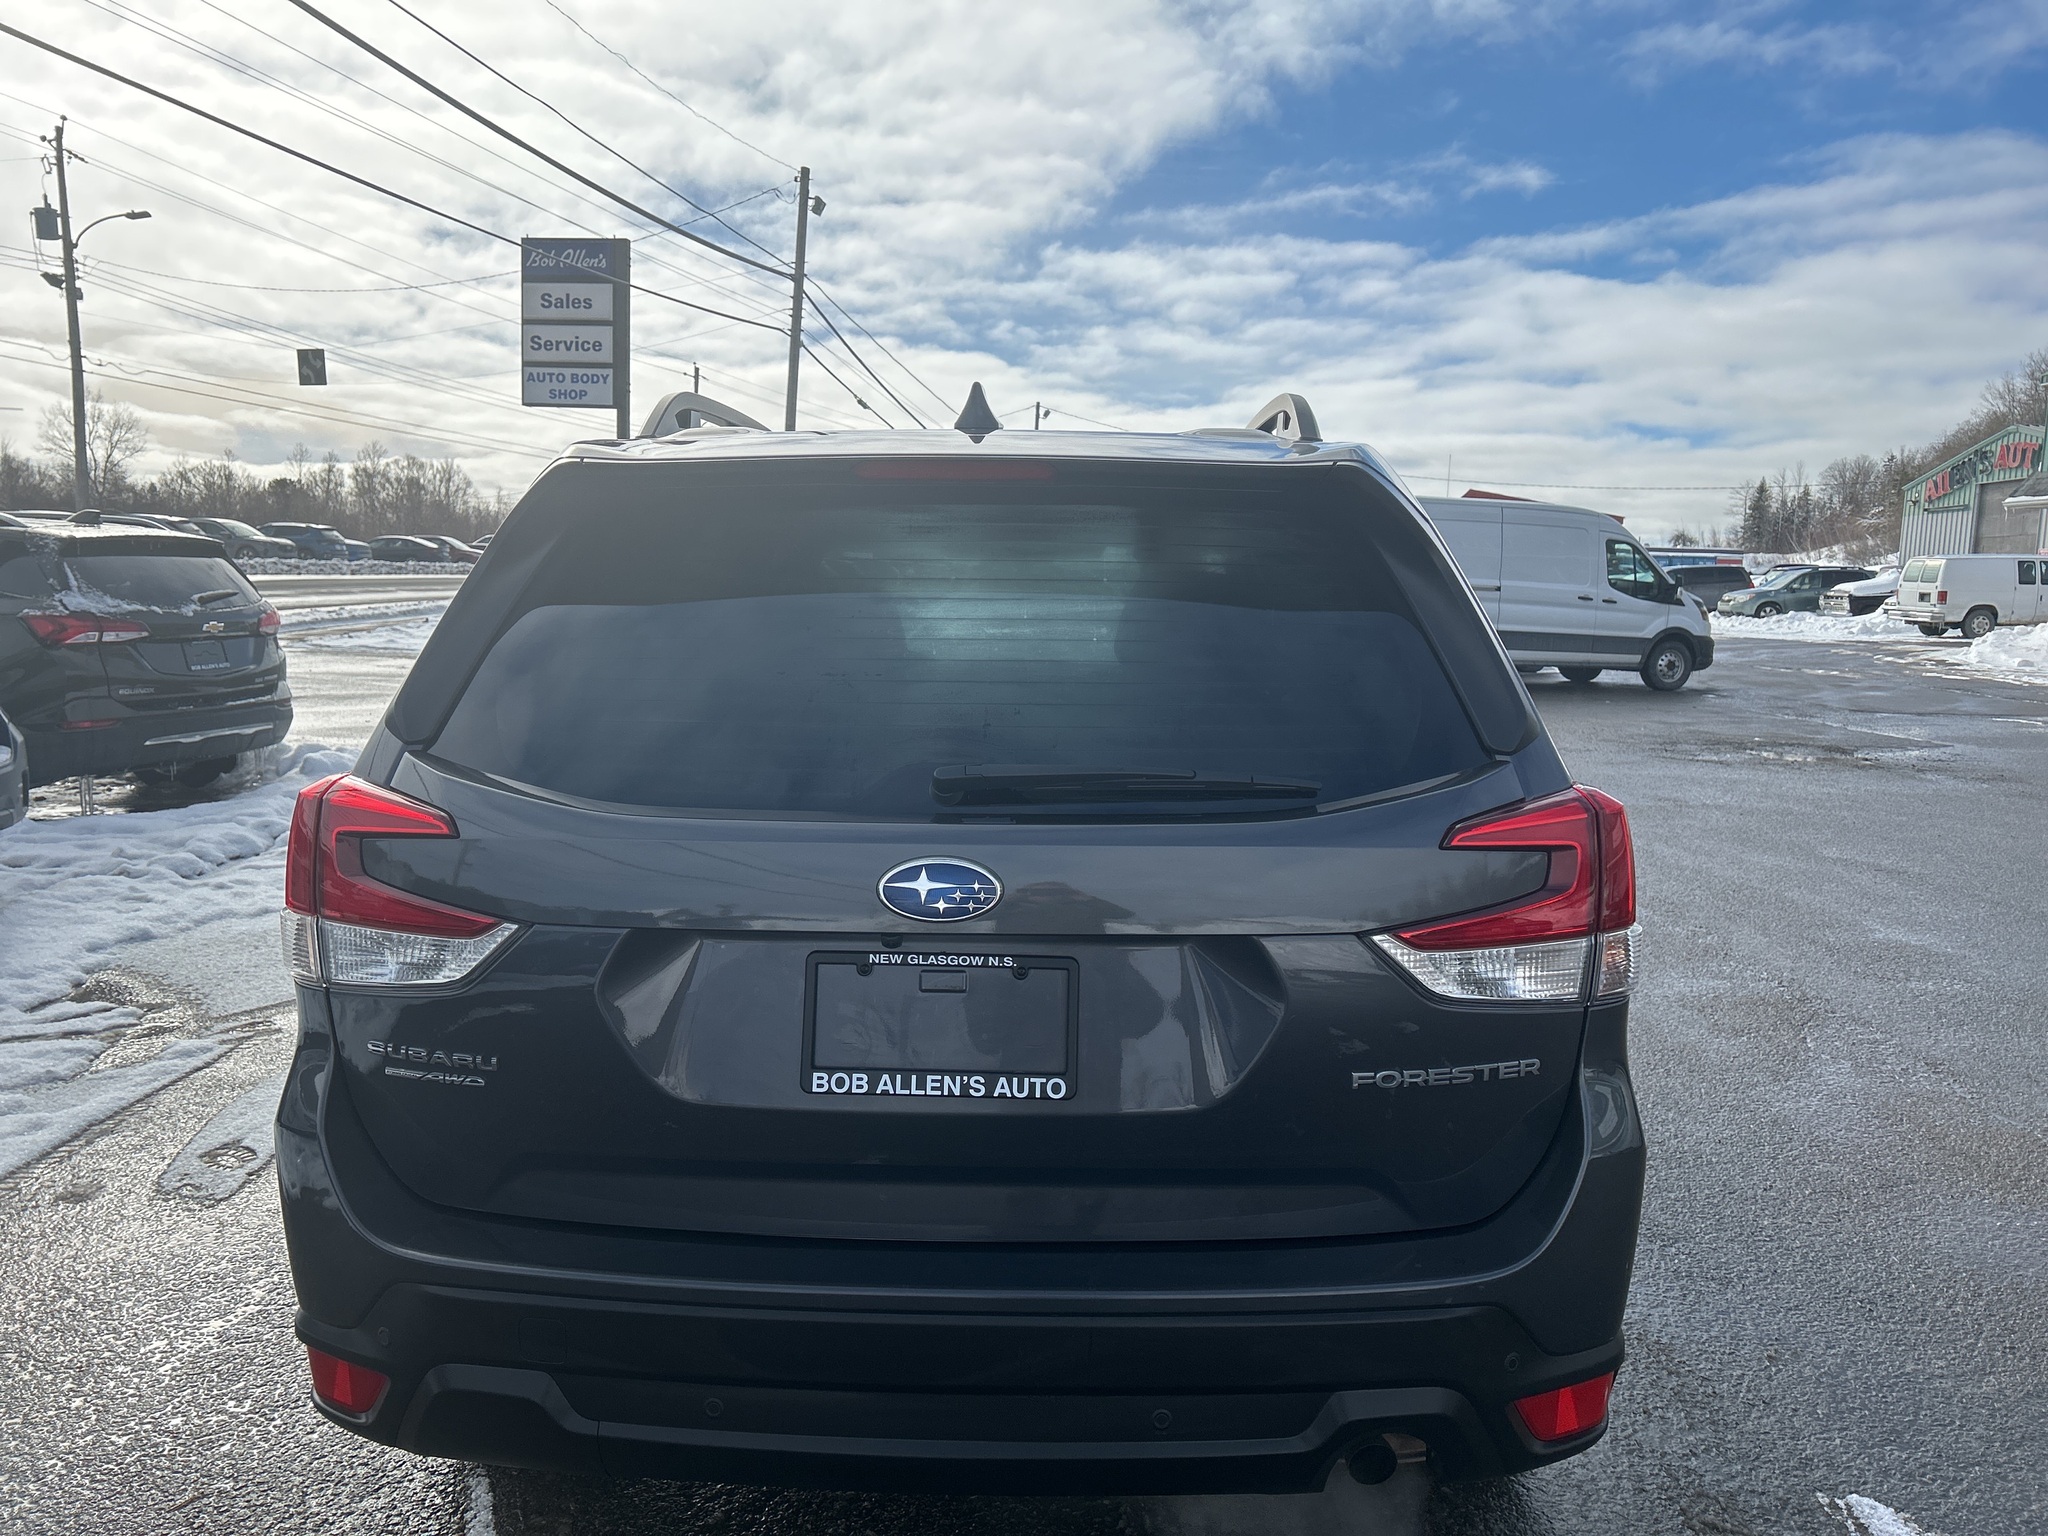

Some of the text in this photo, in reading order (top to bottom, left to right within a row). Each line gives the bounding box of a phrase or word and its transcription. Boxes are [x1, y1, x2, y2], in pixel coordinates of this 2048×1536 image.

[526, 249, 607, 268] Bob Allen's
[540, 293, 593, 310] Sales
[529, 335, 603, 352] Service
[526, 372, 610, 385] AUTO BODY
[548, 388, 588, 400] SHOP
[868, 953, 1018, 967] NEW GLASGOW N.S.
[366, 1040, 498, 1071] SUBARU
[420, 1071, 485, 1086] AWD
[1351, 1058, 1541, 1090] FORESTER
[811, 1072, 1067, 1099] BOB ALLEN'S AUTO
